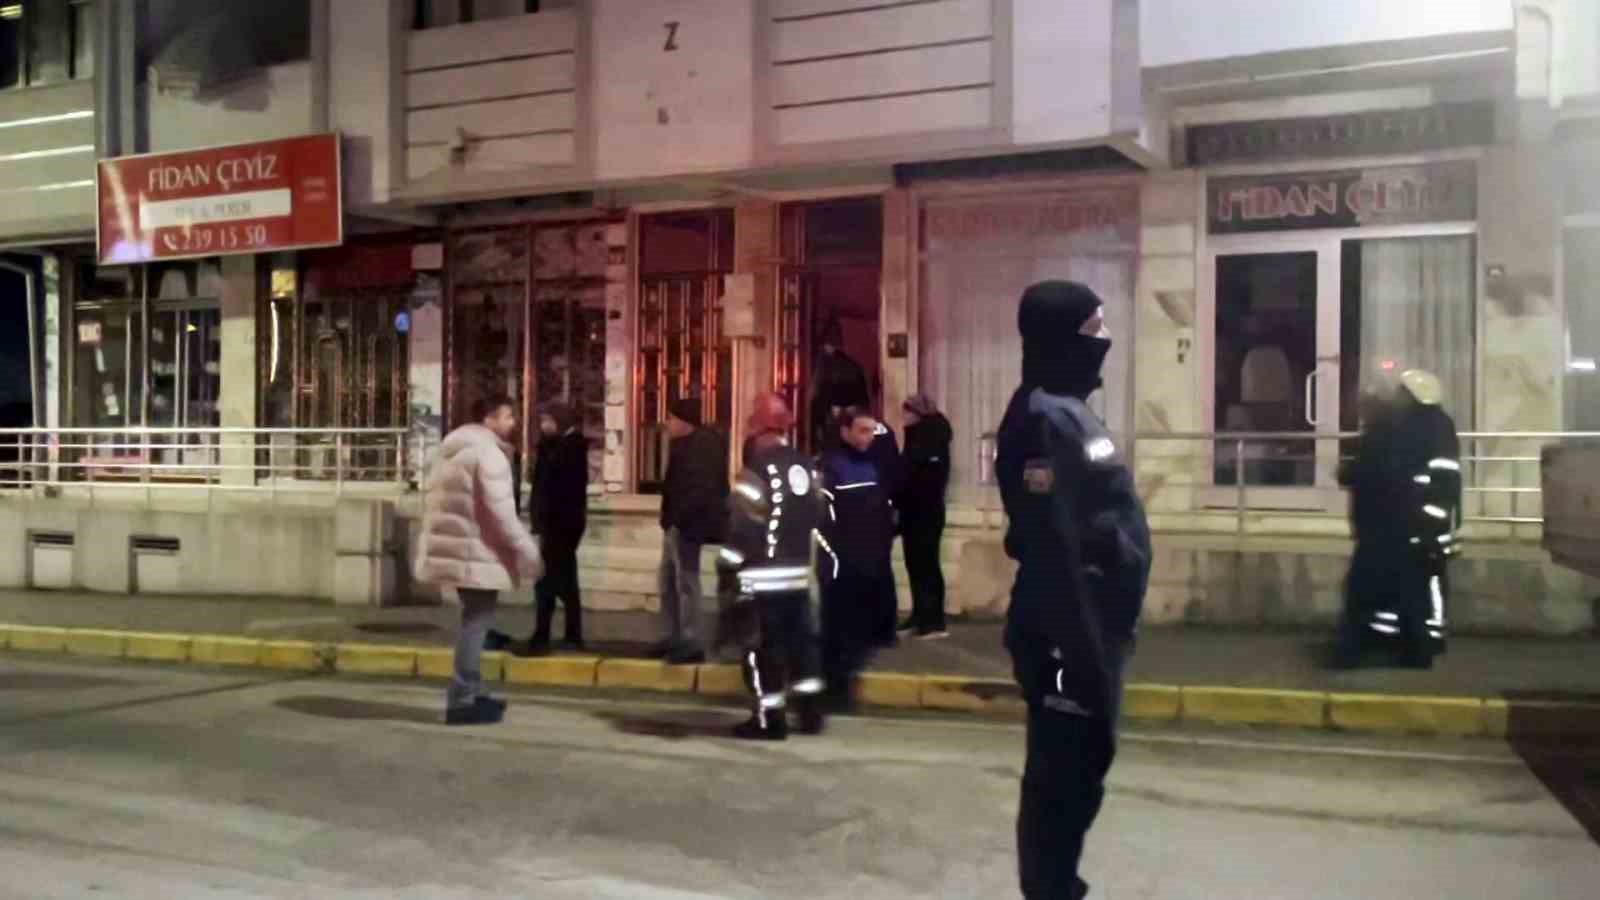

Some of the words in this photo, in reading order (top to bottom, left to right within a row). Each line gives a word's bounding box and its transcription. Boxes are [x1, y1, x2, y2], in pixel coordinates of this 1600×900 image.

[147, 160, 211, 192] FİDAN
[216, 151, 279, 191] ÇEYİZ
[219, 226, 238, 248] 15
[244, 223, 267, 246] 50
